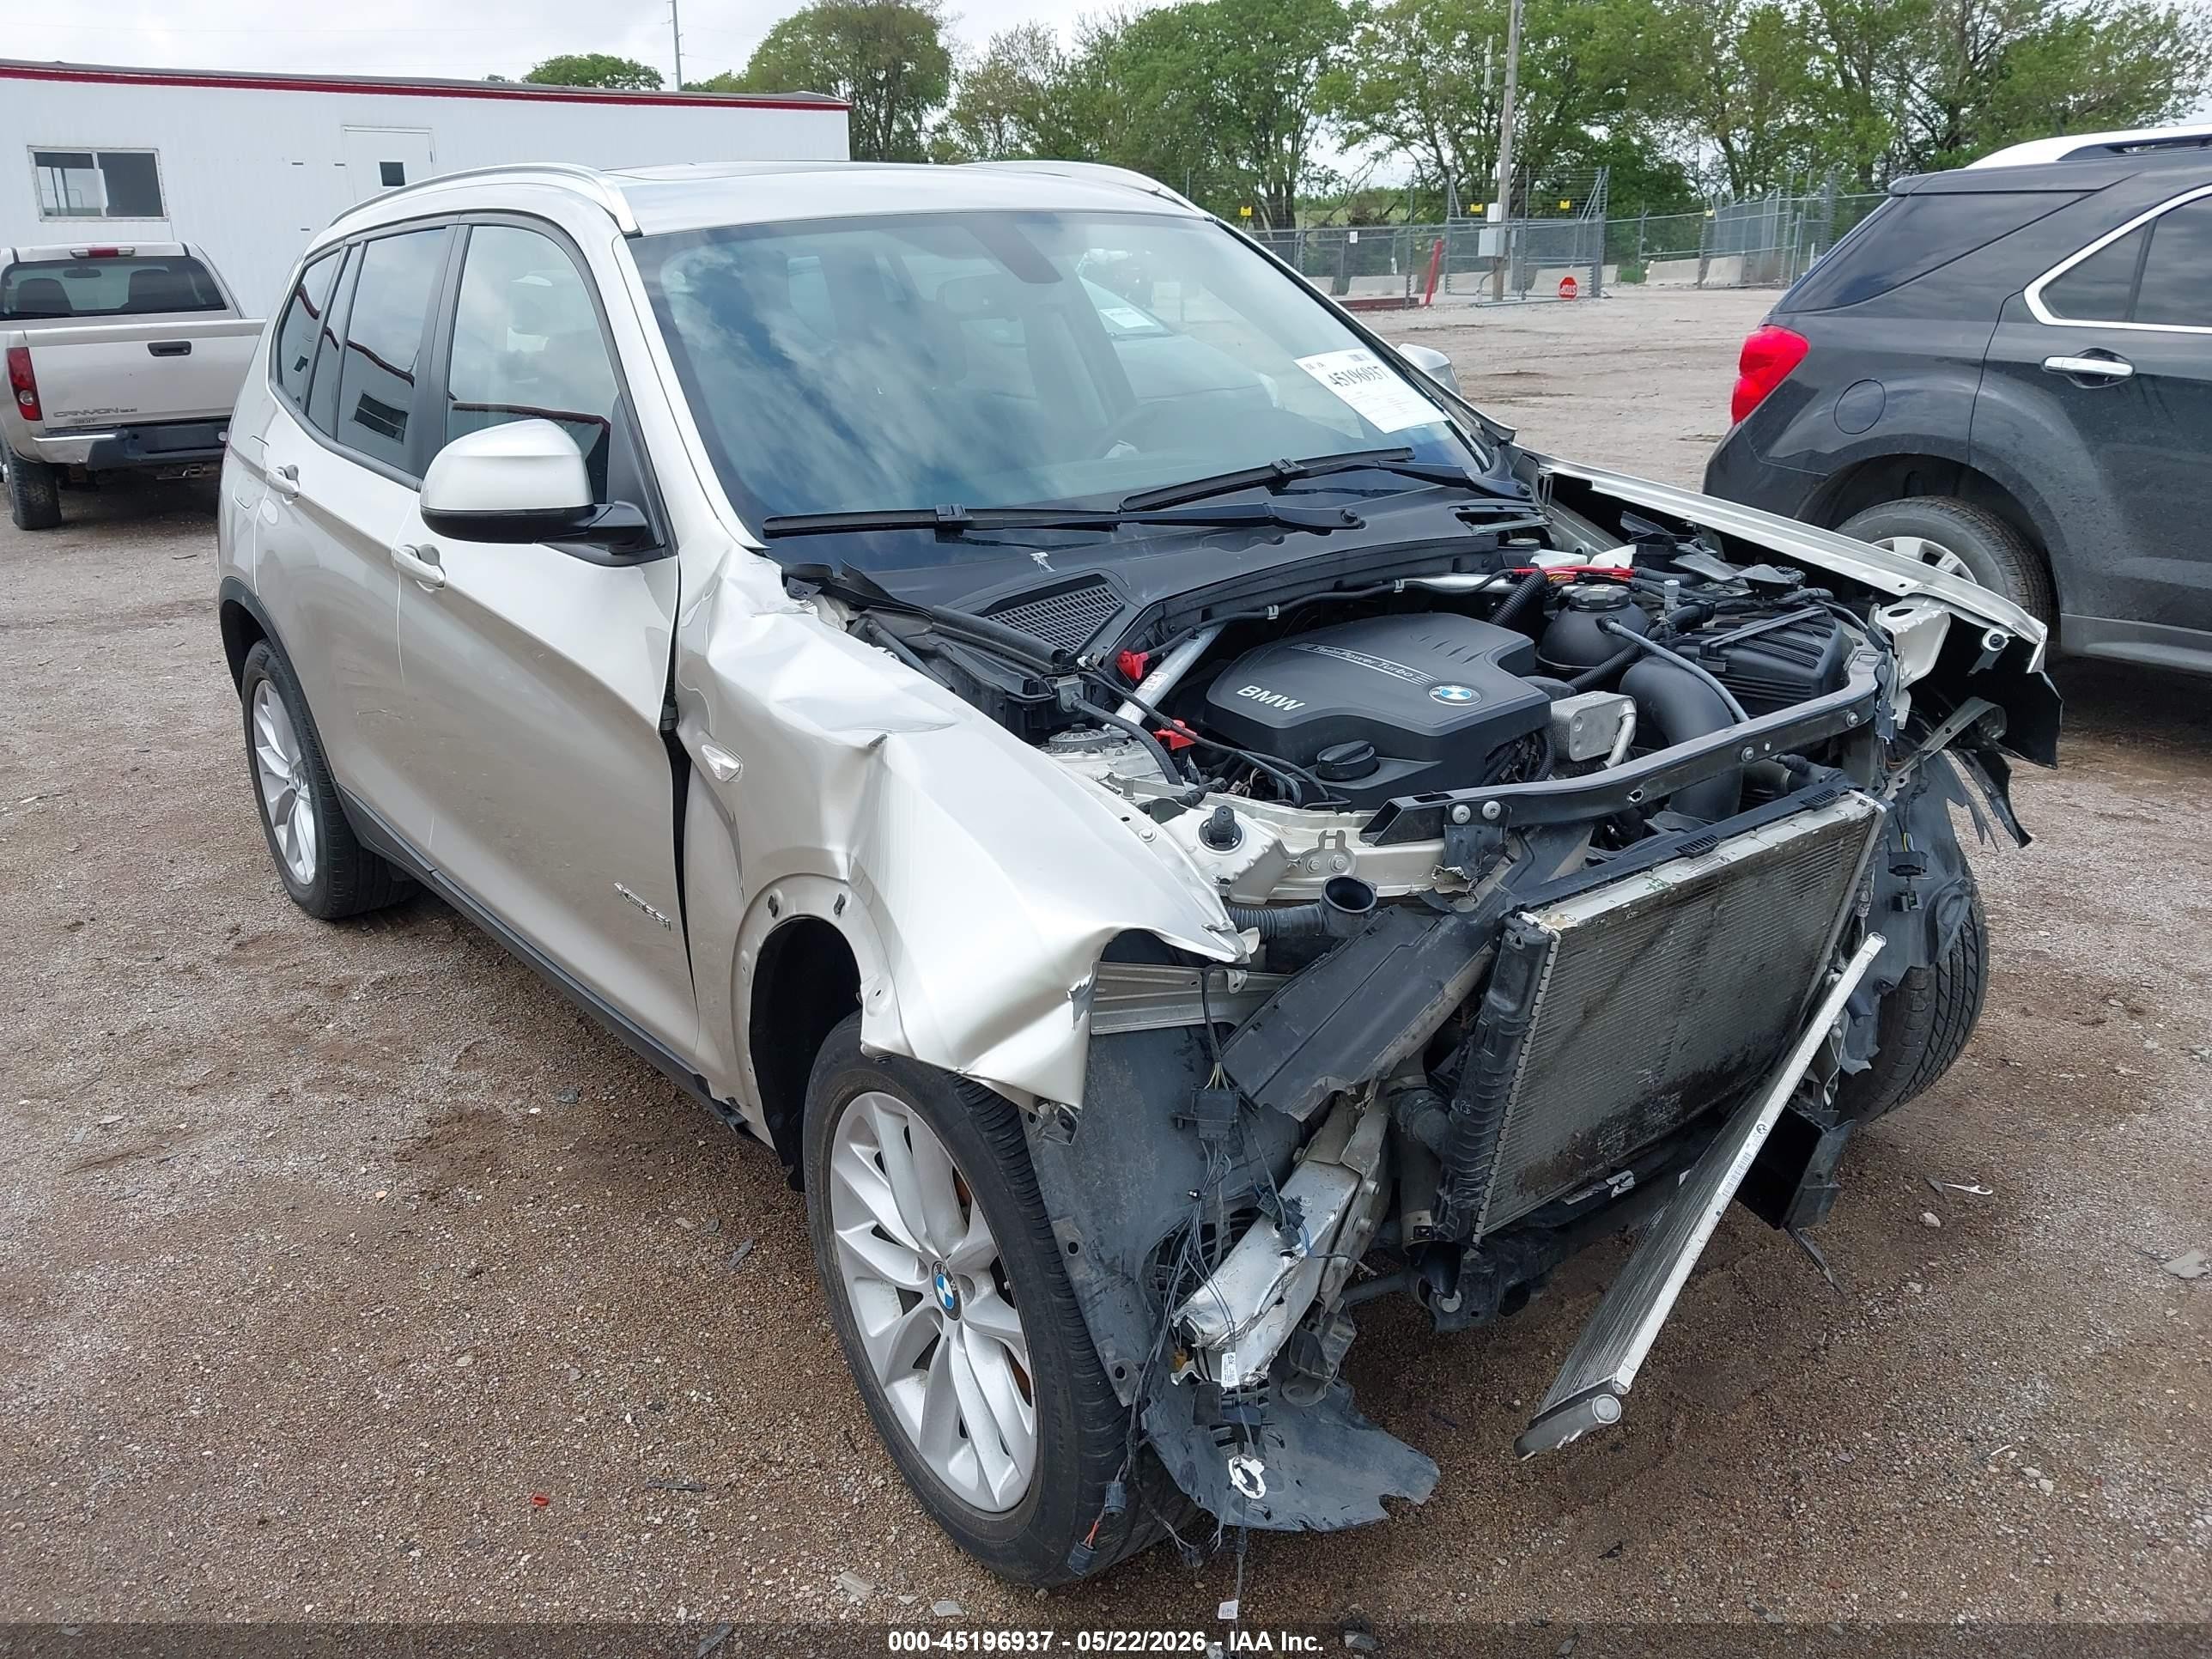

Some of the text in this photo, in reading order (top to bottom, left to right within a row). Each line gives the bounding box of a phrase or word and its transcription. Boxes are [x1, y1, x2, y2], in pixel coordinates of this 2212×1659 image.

[1328, 366, 1389, 387] 45196937
[53, 407, 118, 418] CANYON
[1377, 661, 1413, 678] Turbo
[1236, 684, 1306, 712] BMW
